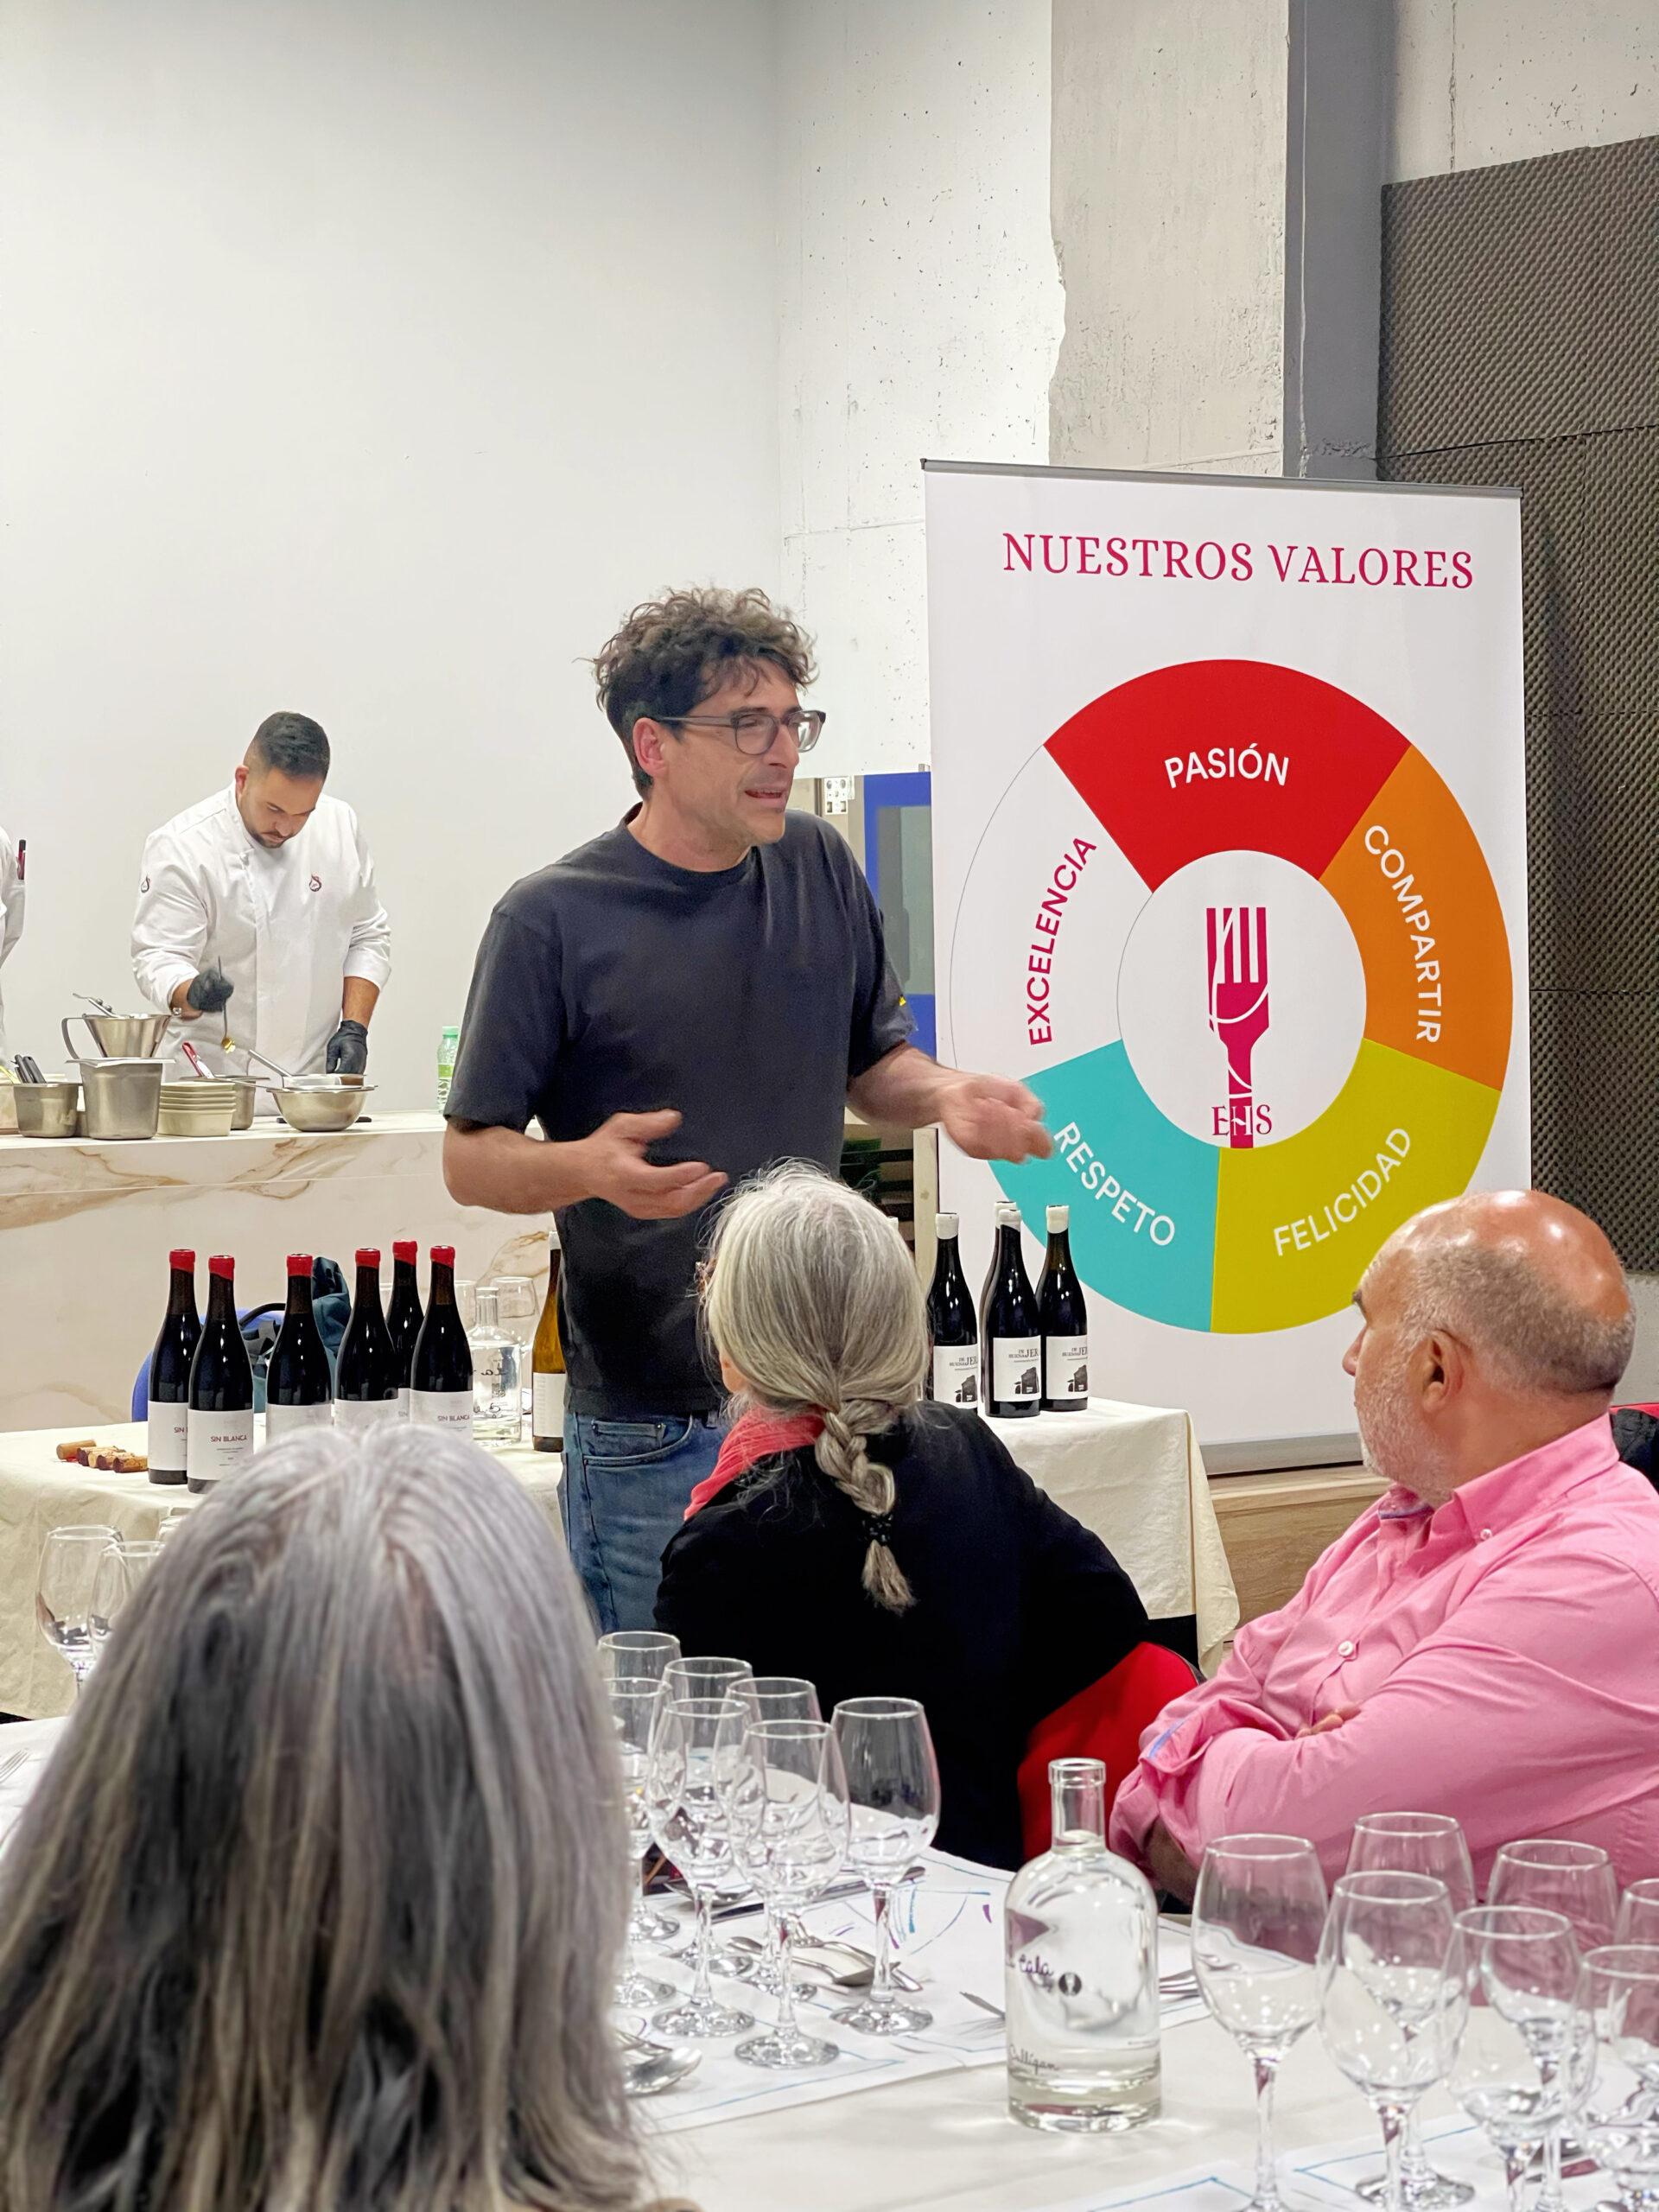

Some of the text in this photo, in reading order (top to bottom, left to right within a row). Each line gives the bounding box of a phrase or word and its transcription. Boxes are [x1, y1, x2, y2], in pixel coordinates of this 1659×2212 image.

[1002, 532, 1473, 589] NUESTROS VALORES
[1164, 742, 1289, 789] PASIÓN
[1026, 836, 1097, 1046] EXCELENCIA
[1363, 824, 1442, 1044] COMPARTIR
[1211, 1103, 1272, 1135] EHS
[1052, 1121, 1176, 1247] RESPETO
[1272, 1127, 1412, 1258] FELICIDAD
